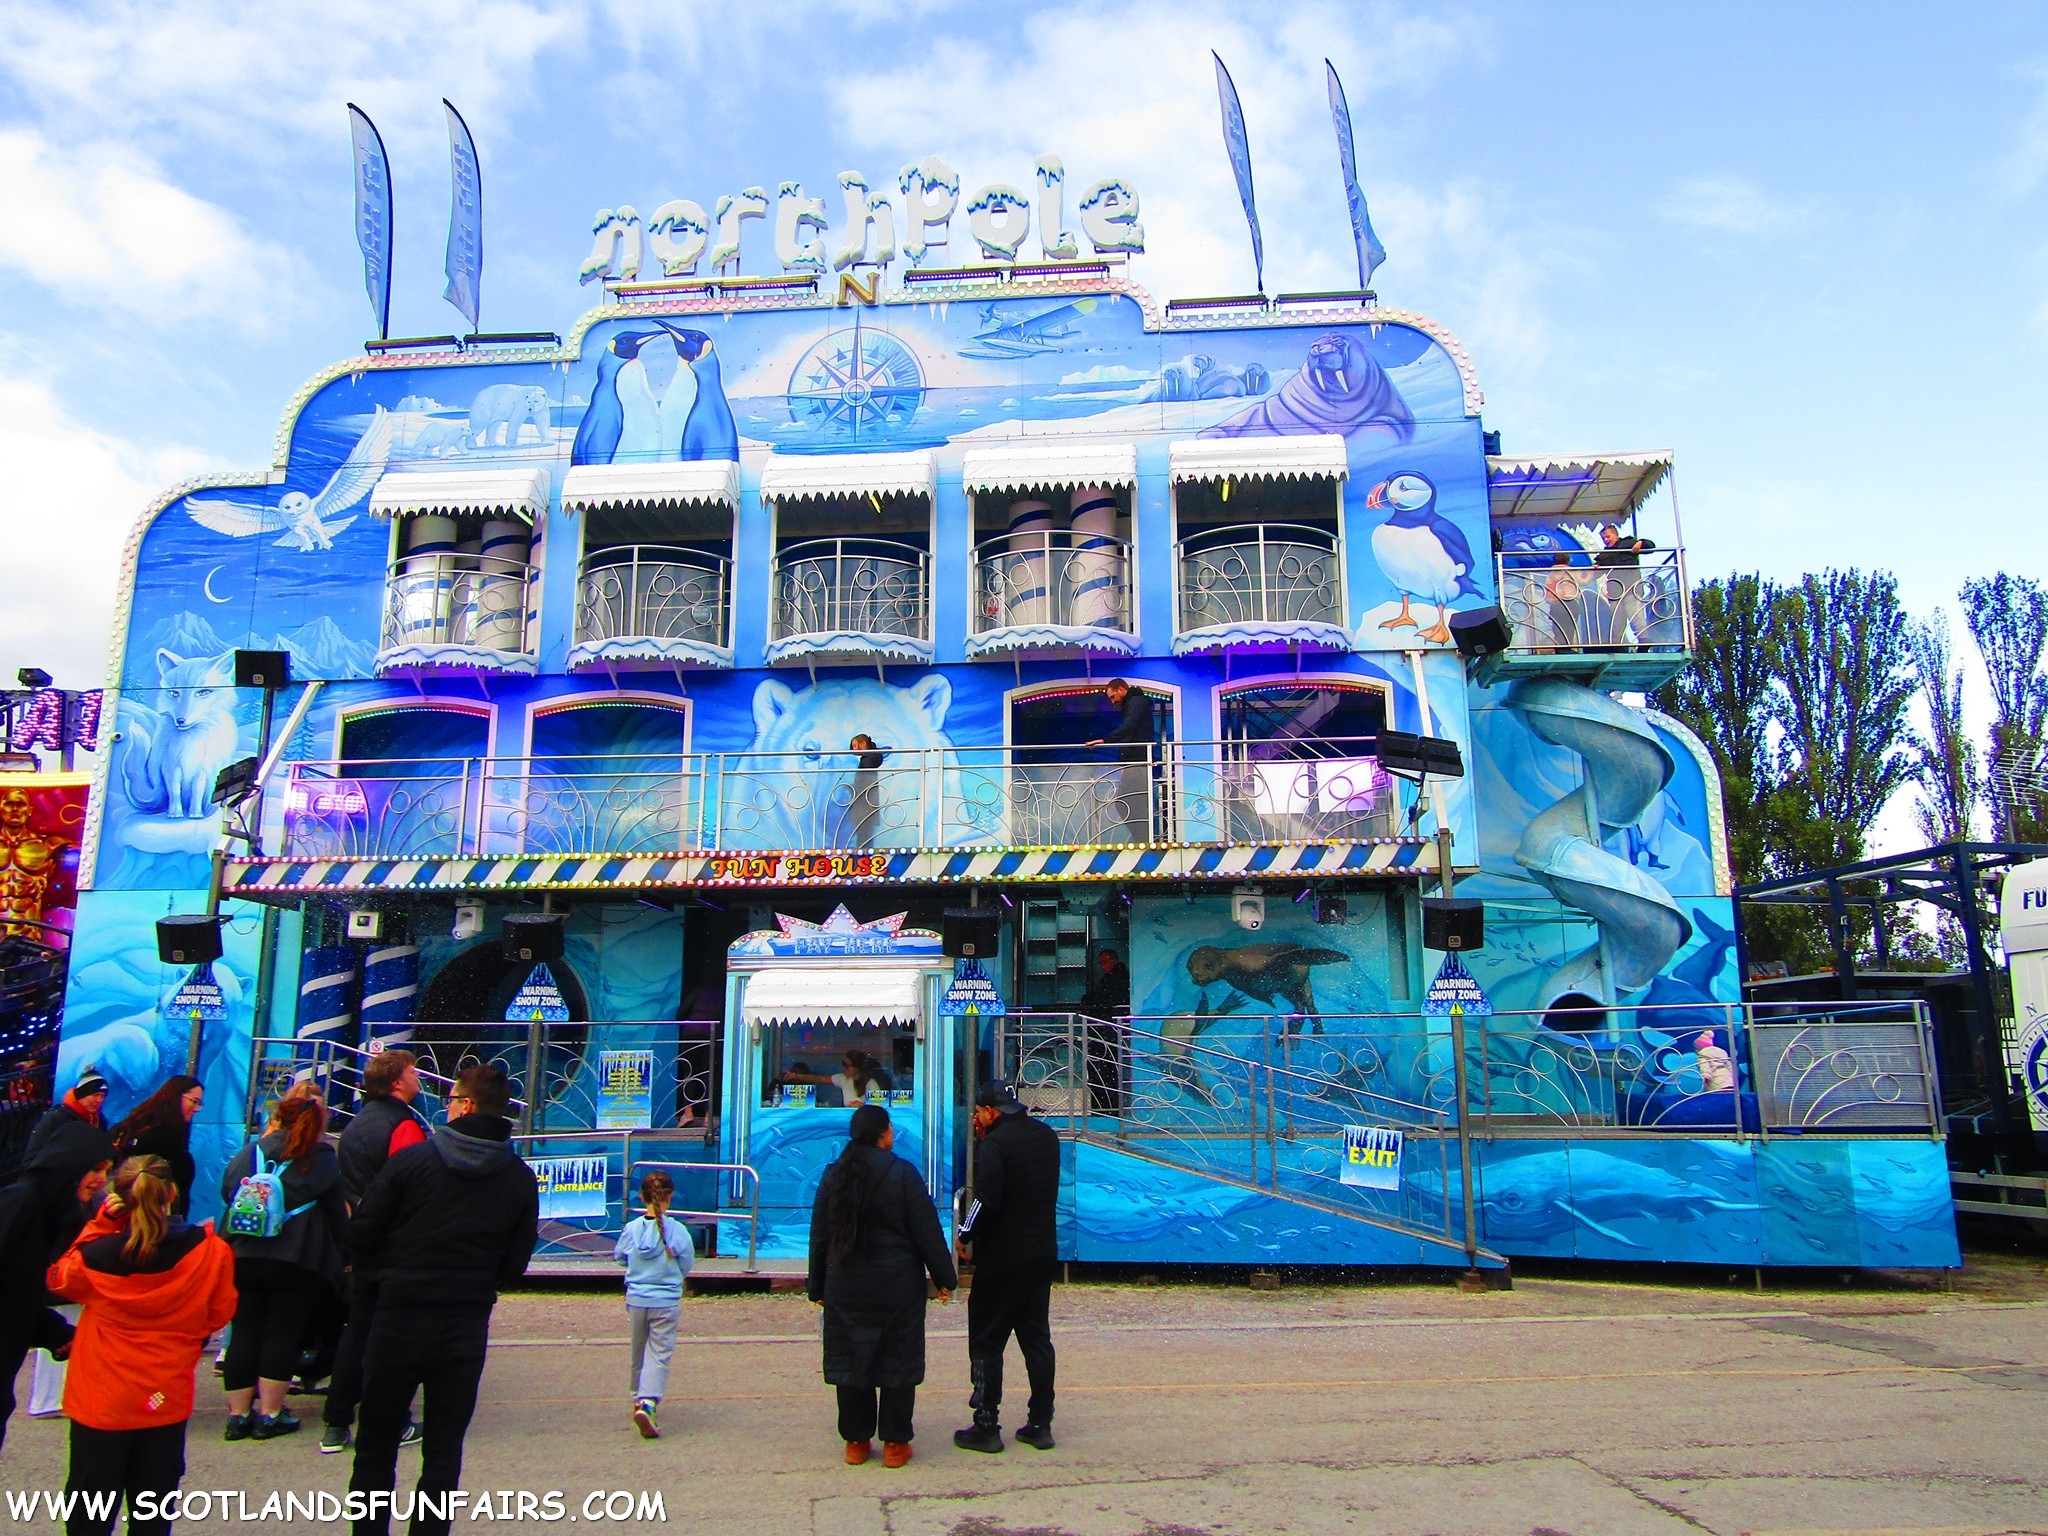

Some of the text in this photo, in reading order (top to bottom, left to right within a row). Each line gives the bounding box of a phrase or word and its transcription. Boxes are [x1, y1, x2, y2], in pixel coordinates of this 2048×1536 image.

[837, 273, 879, 308] N
[710, 856, 889, 878] FUN HOUSE
[794, 936, 898, 955] PAY HERE
[954, 980, 992, 990] WARNING
[1435, 979, 1475, 989] WARNING
[182, 985, 218, 995] WARNING
[522, 986, 558, 996] WARNING
[948, 990, 997, 1000] SNOW ZONE
[1429, 990, 1482, 1000] SNOW ZONE
[175, 995, 222, 1005] SNOW ZONE
[515, 996, 562, 1006] SNOW ZONE
[1348, 1146, 1397, 1168] EXIT
[554, 1181, 604, 1192] ENTRANCE
